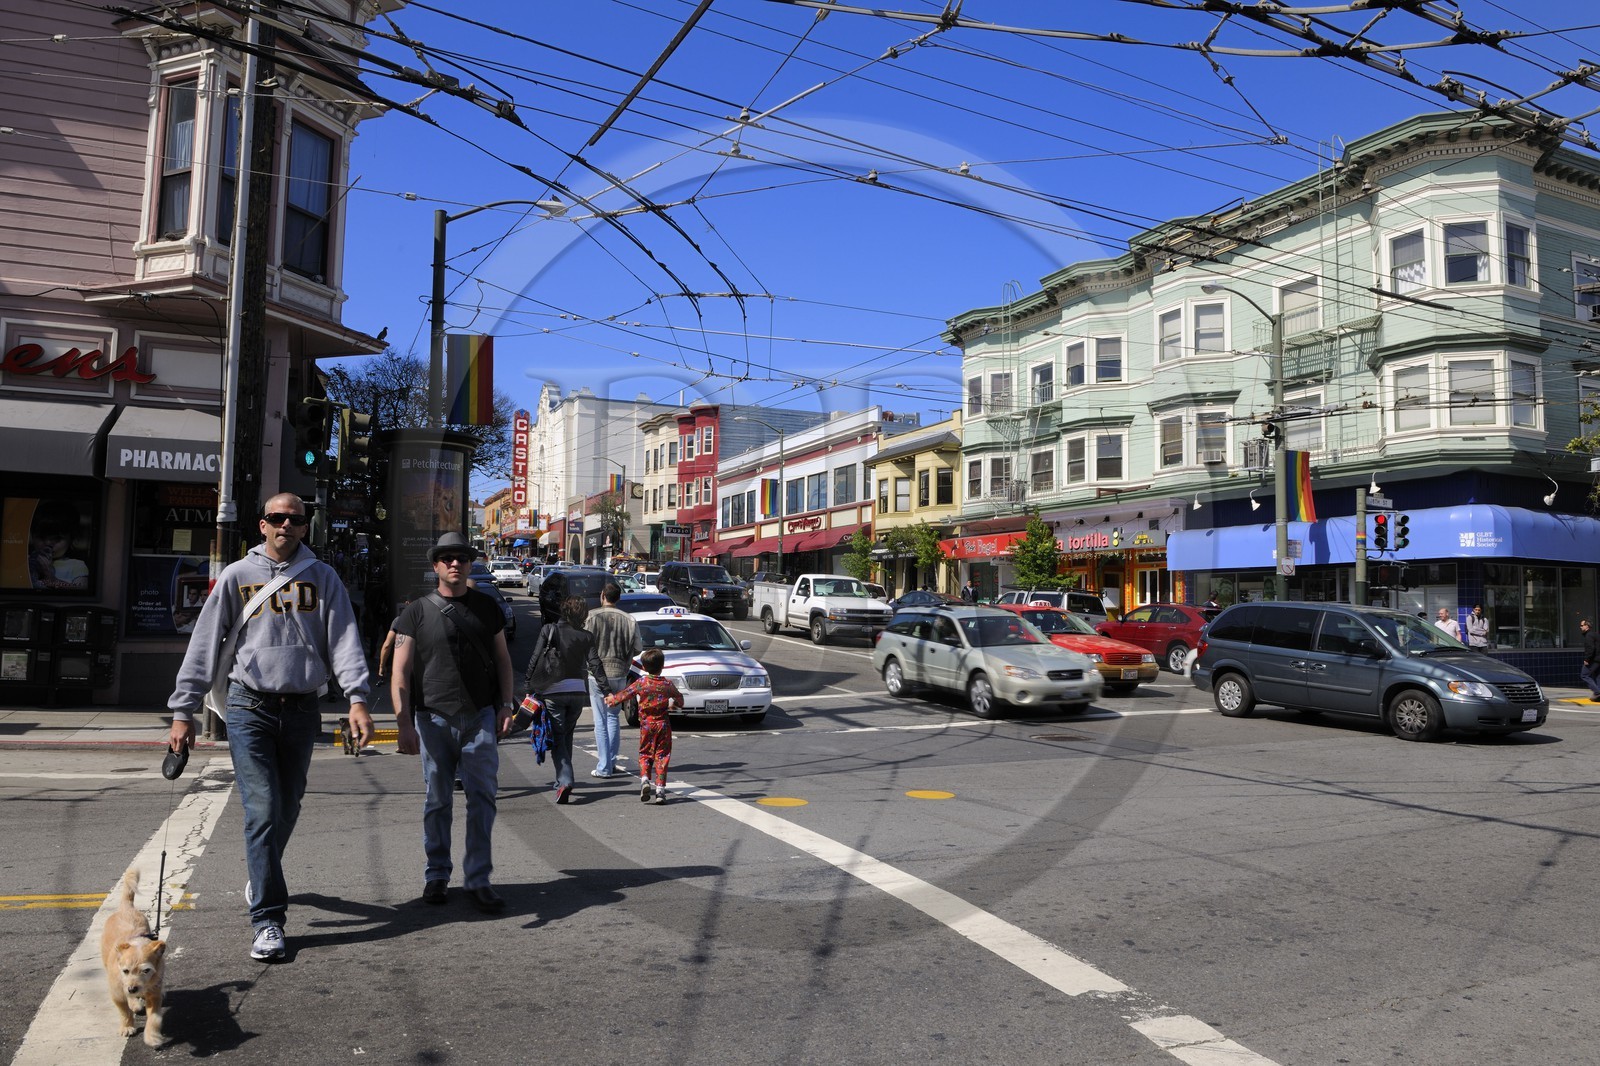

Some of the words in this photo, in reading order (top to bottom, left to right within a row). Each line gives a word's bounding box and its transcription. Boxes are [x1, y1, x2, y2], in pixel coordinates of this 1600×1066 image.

[412, 458, 461, 471] Petchitecture
[514, 418, 527, 503] CASTRO
[168, 496, 212, 505] FARGO
[165, 507, 213, 523] ATM
[1053, 540, 1064, 551] a
[1068, 532, 1109, 550] tortilla
